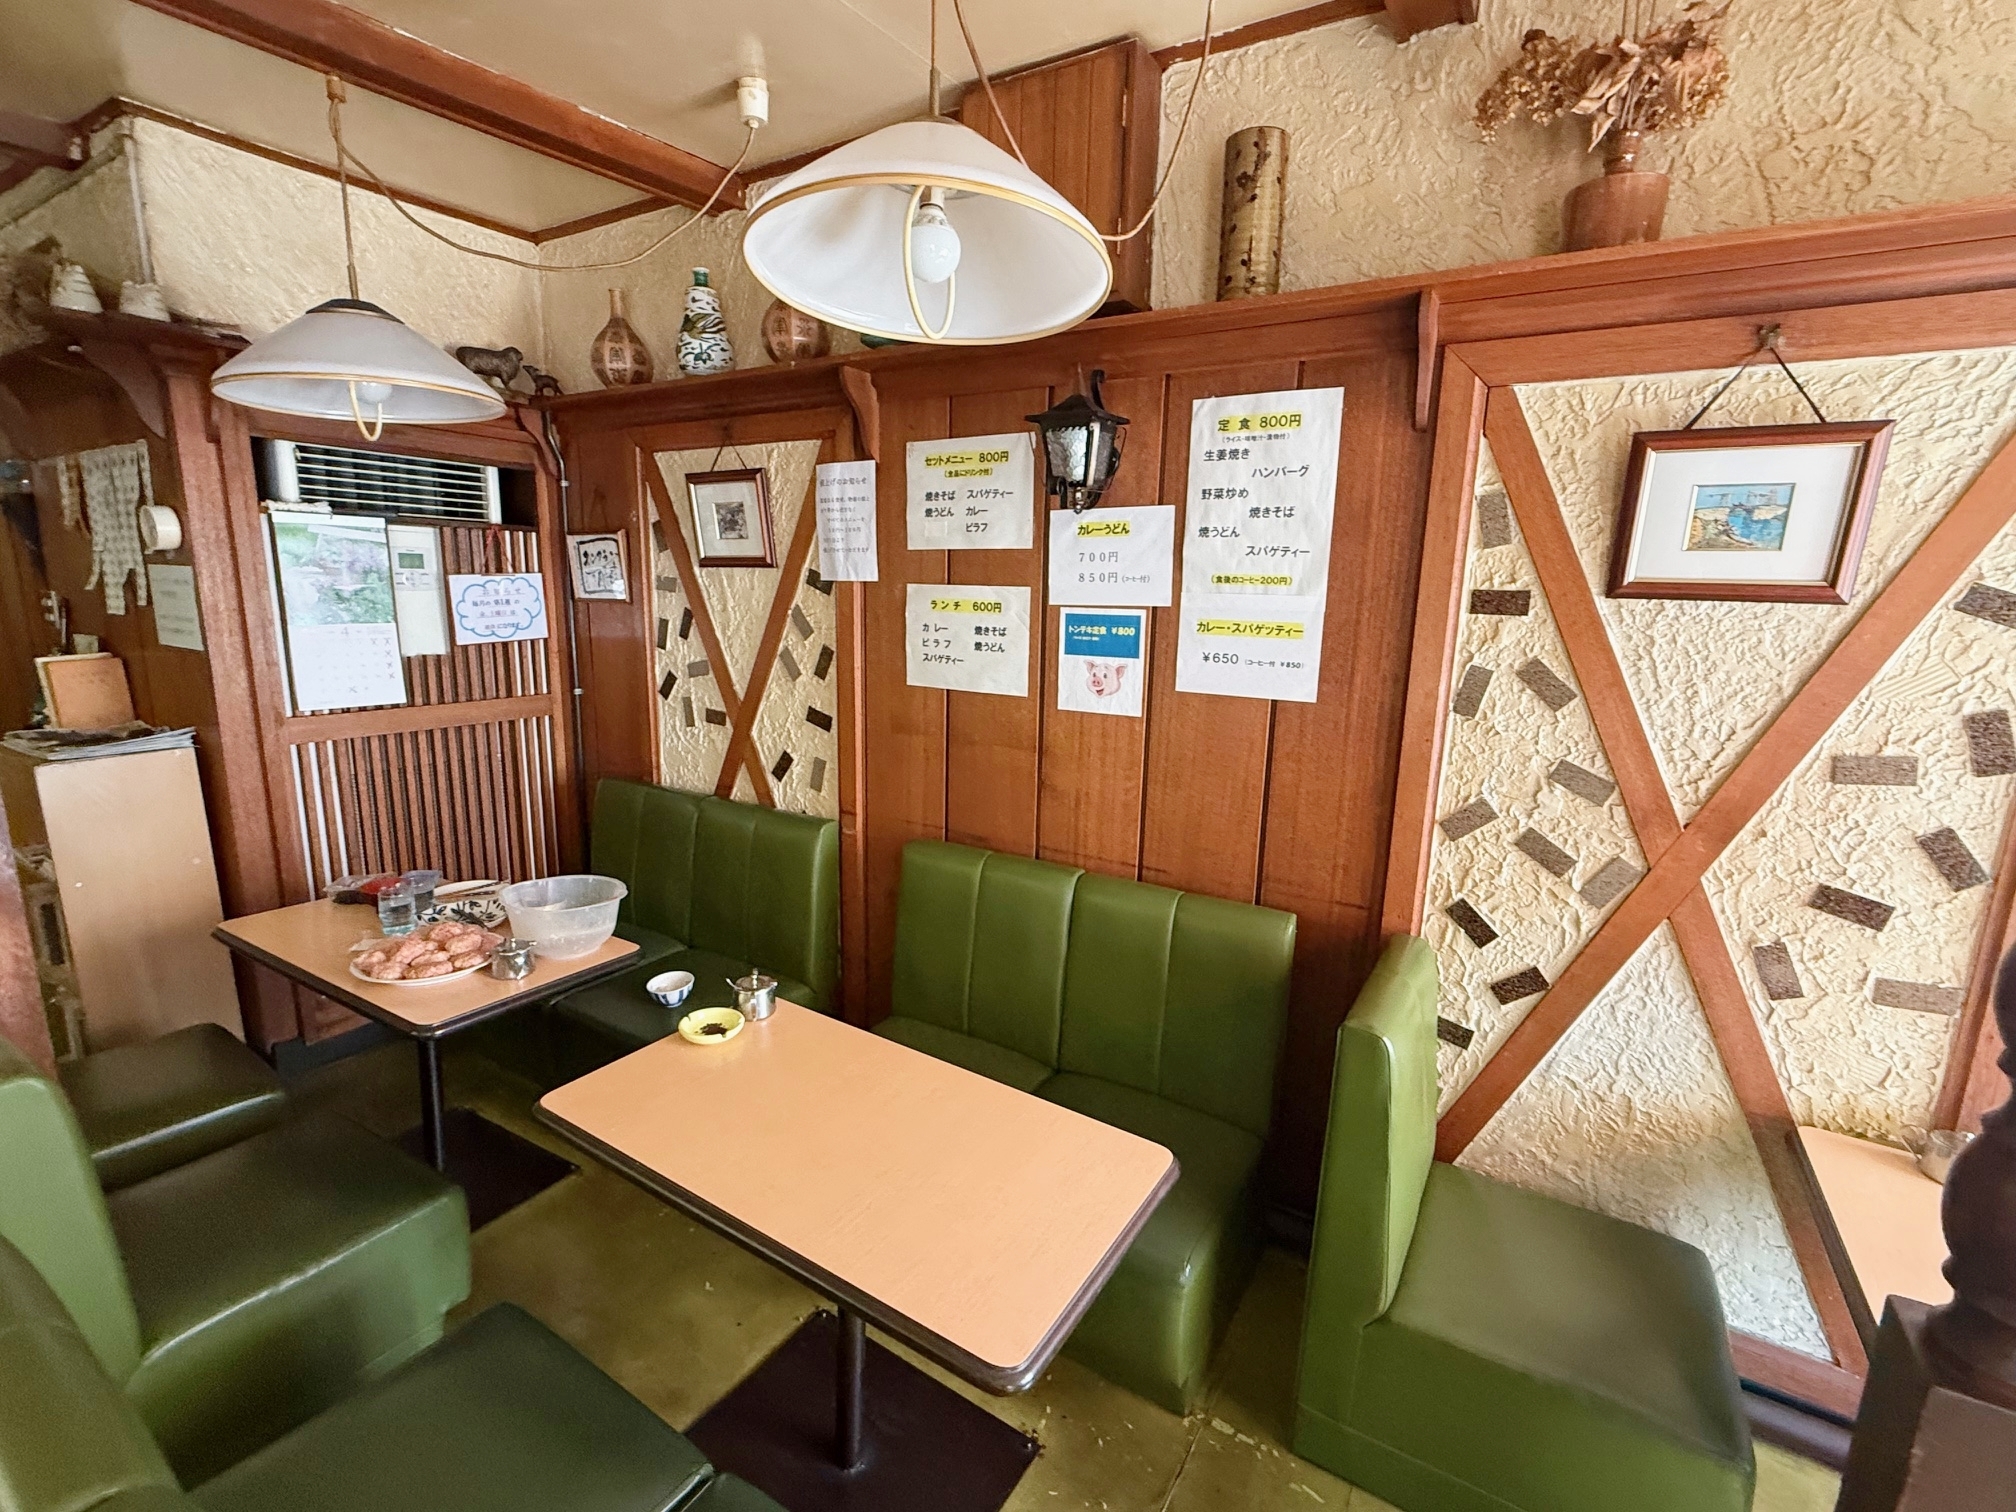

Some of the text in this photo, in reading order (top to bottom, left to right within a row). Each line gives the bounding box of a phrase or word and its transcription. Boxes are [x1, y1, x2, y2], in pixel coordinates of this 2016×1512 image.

[1217, 413, 1302, 432] 定食 800円
[925, 450, 1009, 466] セットメニュー 800円
[1203, 448, 1251, 462] 生姜焼き
[1251, 464, 1310, 478] ハンバーグ
[925, 490, 956, 501] 焼きそば
[1201, 488, 1249, 500] 野菜炒め
[924, 506, 988, 518] 焼うどん カレー
[1248, 506, 1295, 519] 焼きそば
[965, 522, 988, 533] ピラフ
[1077, 523, 1130, 536] カレーうどん
[1198, 526, 1240, 538] 焼うどん
[1078, 551, 1119, 563] 700円
[1078, 572, 1118, 583] 850円
[1211, 575, 1293, 586] （食後のコーヒー200円）
[930, 600, 1002, 613] ランチ 600円
[922, 623, 1007, 637] カレー 焼きそば
[1068, 625, 1136, 636] トンテキ定食 ¥800
[922, 638, 1005, 653] ピラフ 焼うどん
[1202, 651, 1239, 665] ¥650
